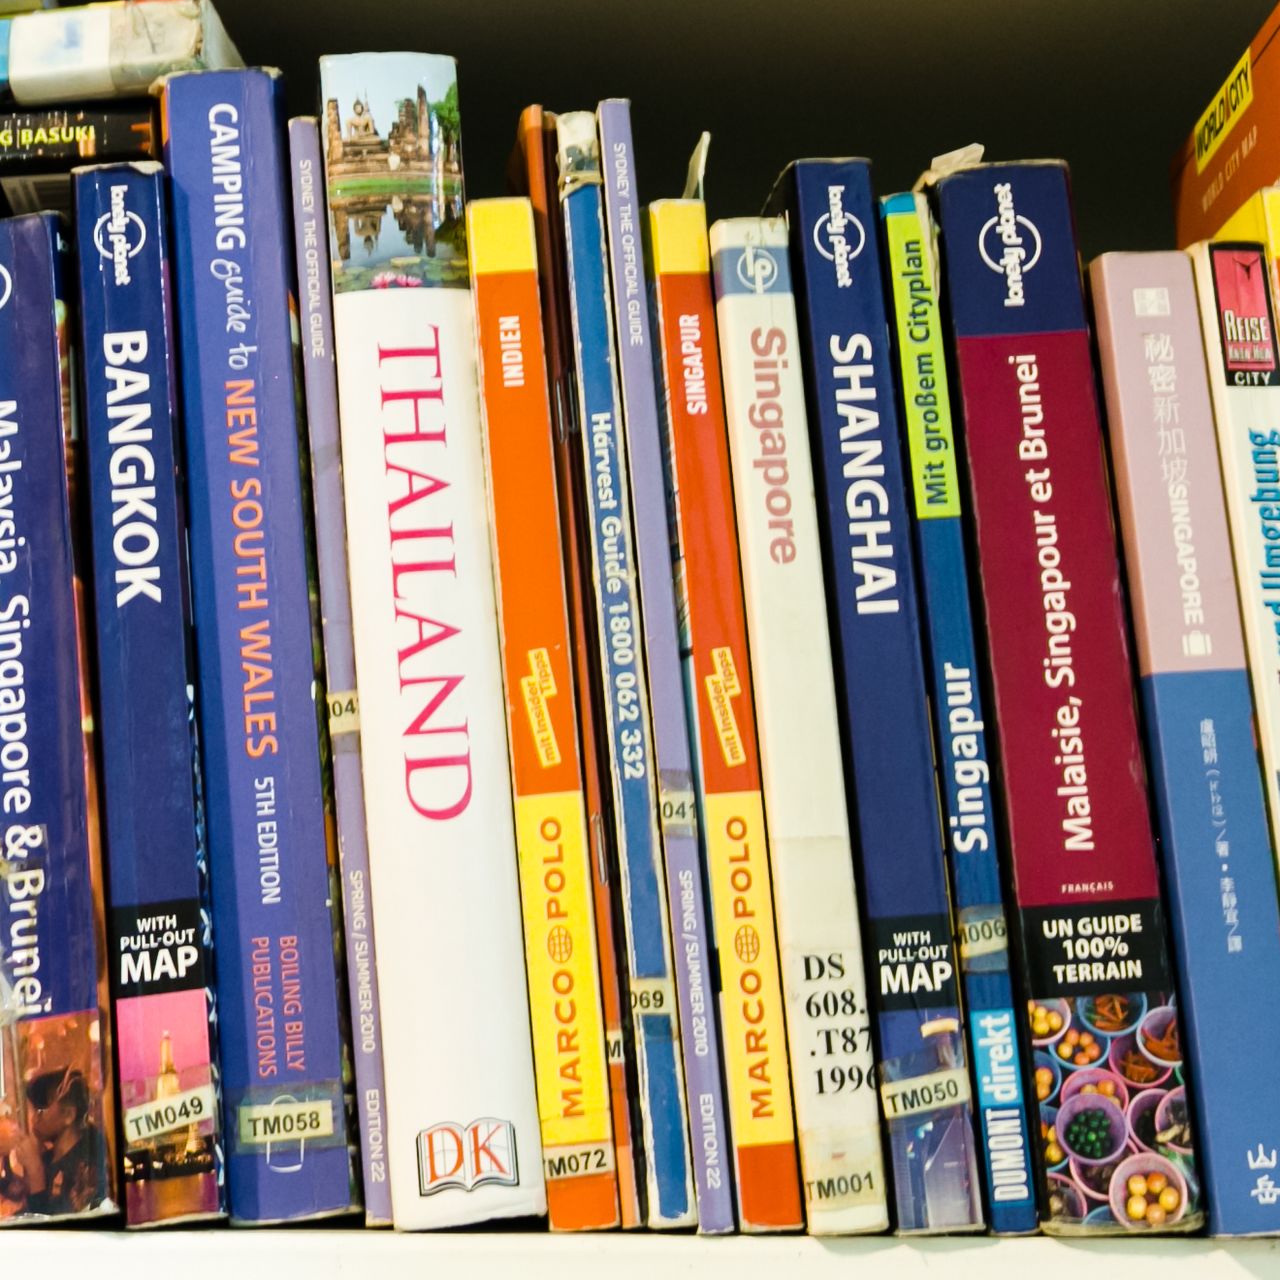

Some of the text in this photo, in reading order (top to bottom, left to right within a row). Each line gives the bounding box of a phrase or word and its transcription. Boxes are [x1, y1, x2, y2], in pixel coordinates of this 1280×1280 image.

[498, 315, 525, 388] INDIEN
[679, 313, 708, 416] SINGAPUR
[902, 237, 950, 506] Mit großem Cityplan
[1235, 371, 1271, 385] CITY
[102, 329, 162, 607] BANGKOK
[207, 102, 278, 760] CAMPING guide to NEW SOUTH WALES
[750, 327, 797, 565] Singapore
[830, 333, 899, 615] SHANGHAI
[377, 325, 473, 822] THAILAND
[591, 412, 645, 780] Harvest Guide 1800 062 332
[1008, 353, 1096, 853] Malaisie, Singapour et Brunei
[944, 662, 990, 854] Singapur
[3, 824, 44, 859] &
[254, 776, 281, 905] 5TH EDITION
[7, 867, 51, 1015] Brunei
[120, 945, 199, 984] MAP
[121, 928, 195, 950] PULL-OUT
[136, 915, 177, 933] WITH
[539, 816, 585, 1118] MARCO POLO
[726, 816, 775, 1119] MARCO POLO
[803, 952, 845, 981] DS
[878, 944, 948, 963] PULL-OUT
[880, 961, 952, 995] MAP
[892, 930, 932, 947] WITH
[1042, 913, 1143, 938] UN GUIDE
[1053, 960, 1143, 984] TERRAIN
[1061, 935, 1128, 960] 100%
[252, 936, 278, 1078] PUBLICATIONS
[278, 935, 305, 1072] BOILING BILLY
[247, 1113, 321, 1138] TM058
[887, 1078, 959, 1114] TM050
[981, 1013, 1030, 1204] DUMONT direkt
